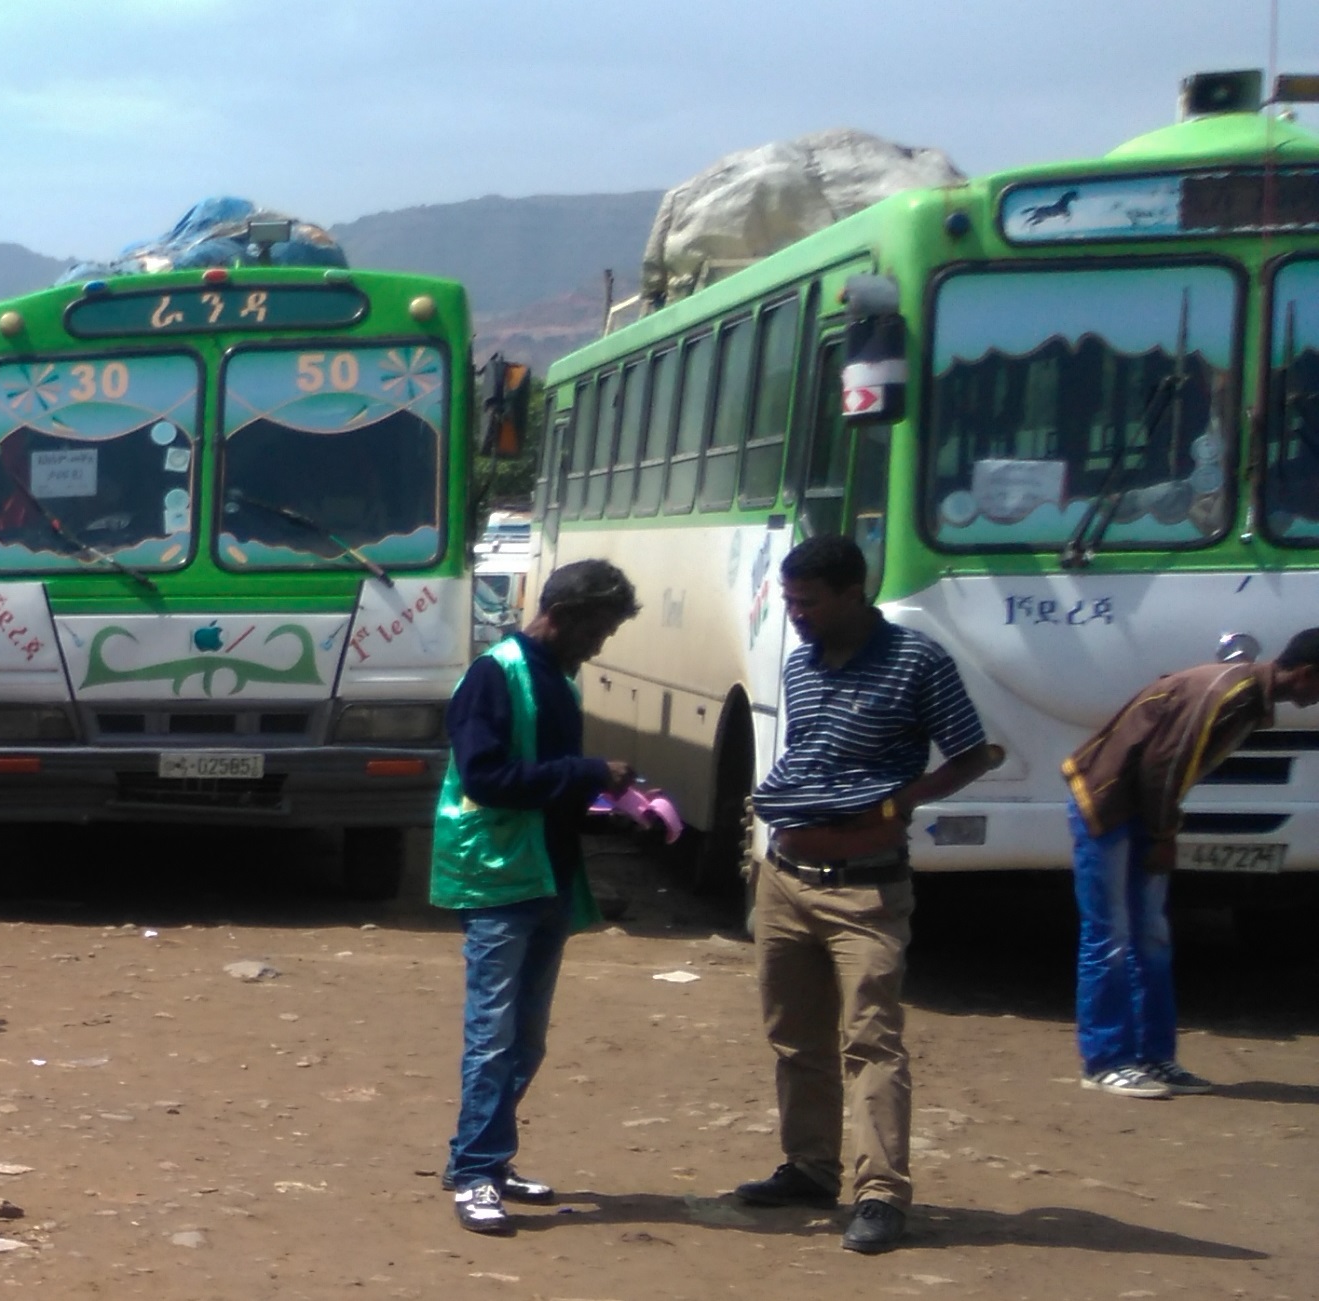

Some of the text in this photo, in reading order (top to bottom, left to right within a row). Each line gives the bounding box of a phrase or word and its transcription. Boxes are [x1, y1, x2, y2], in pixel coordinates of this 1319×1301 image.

[69, 362, 129, 401] 30
[296, 351, 359, 392] 50
[376, 586, 438, 644] level
